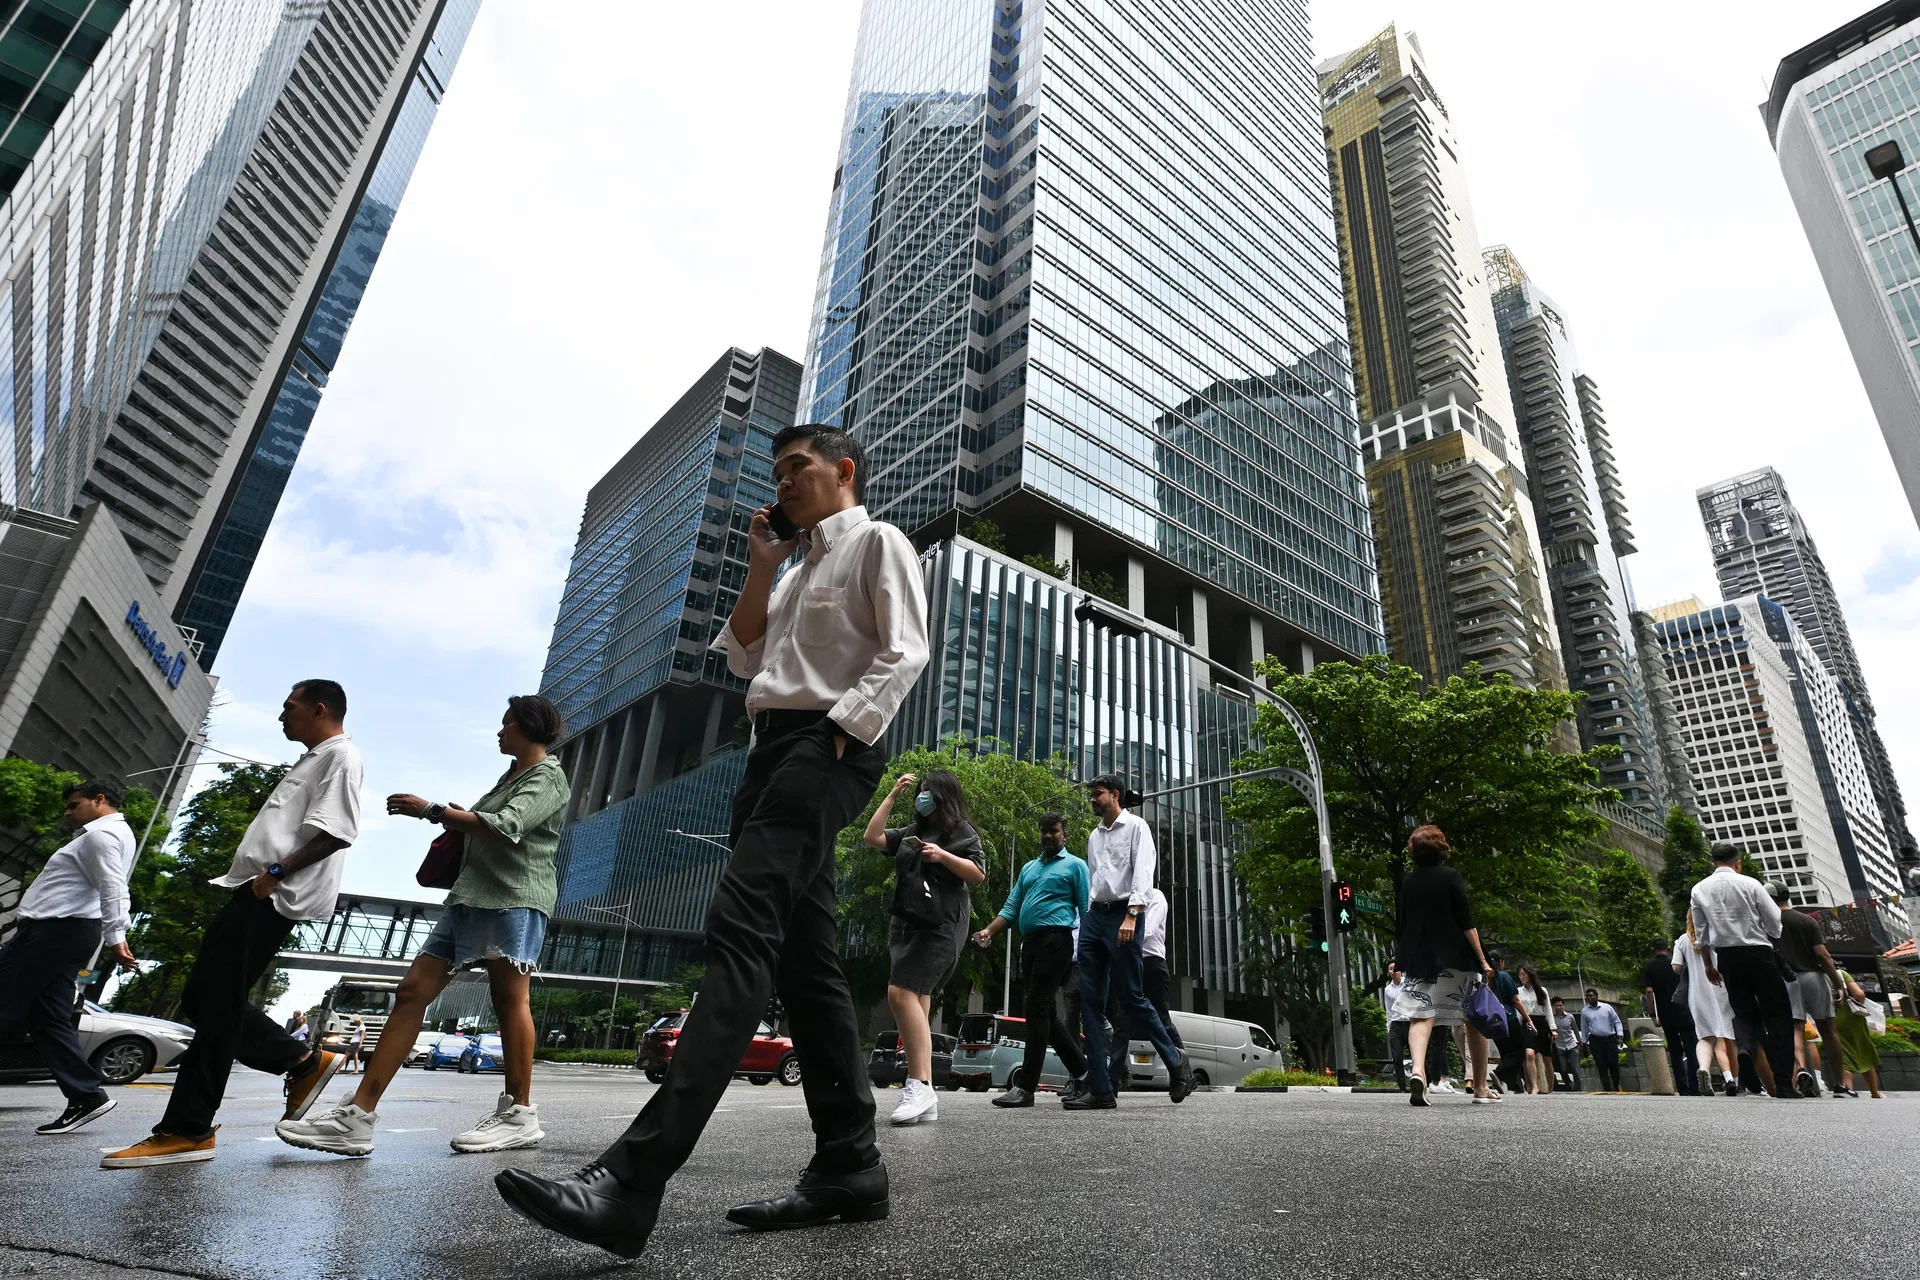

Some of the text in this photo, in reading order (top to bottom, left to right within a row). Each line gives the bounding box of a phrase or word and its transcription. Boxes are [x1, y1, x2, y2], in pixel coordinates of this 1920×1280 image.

[919, 538, 942, 564] anley
[1339, 886, 1350, 901] 13
[1354, 895, 1383, 913] les Quay
